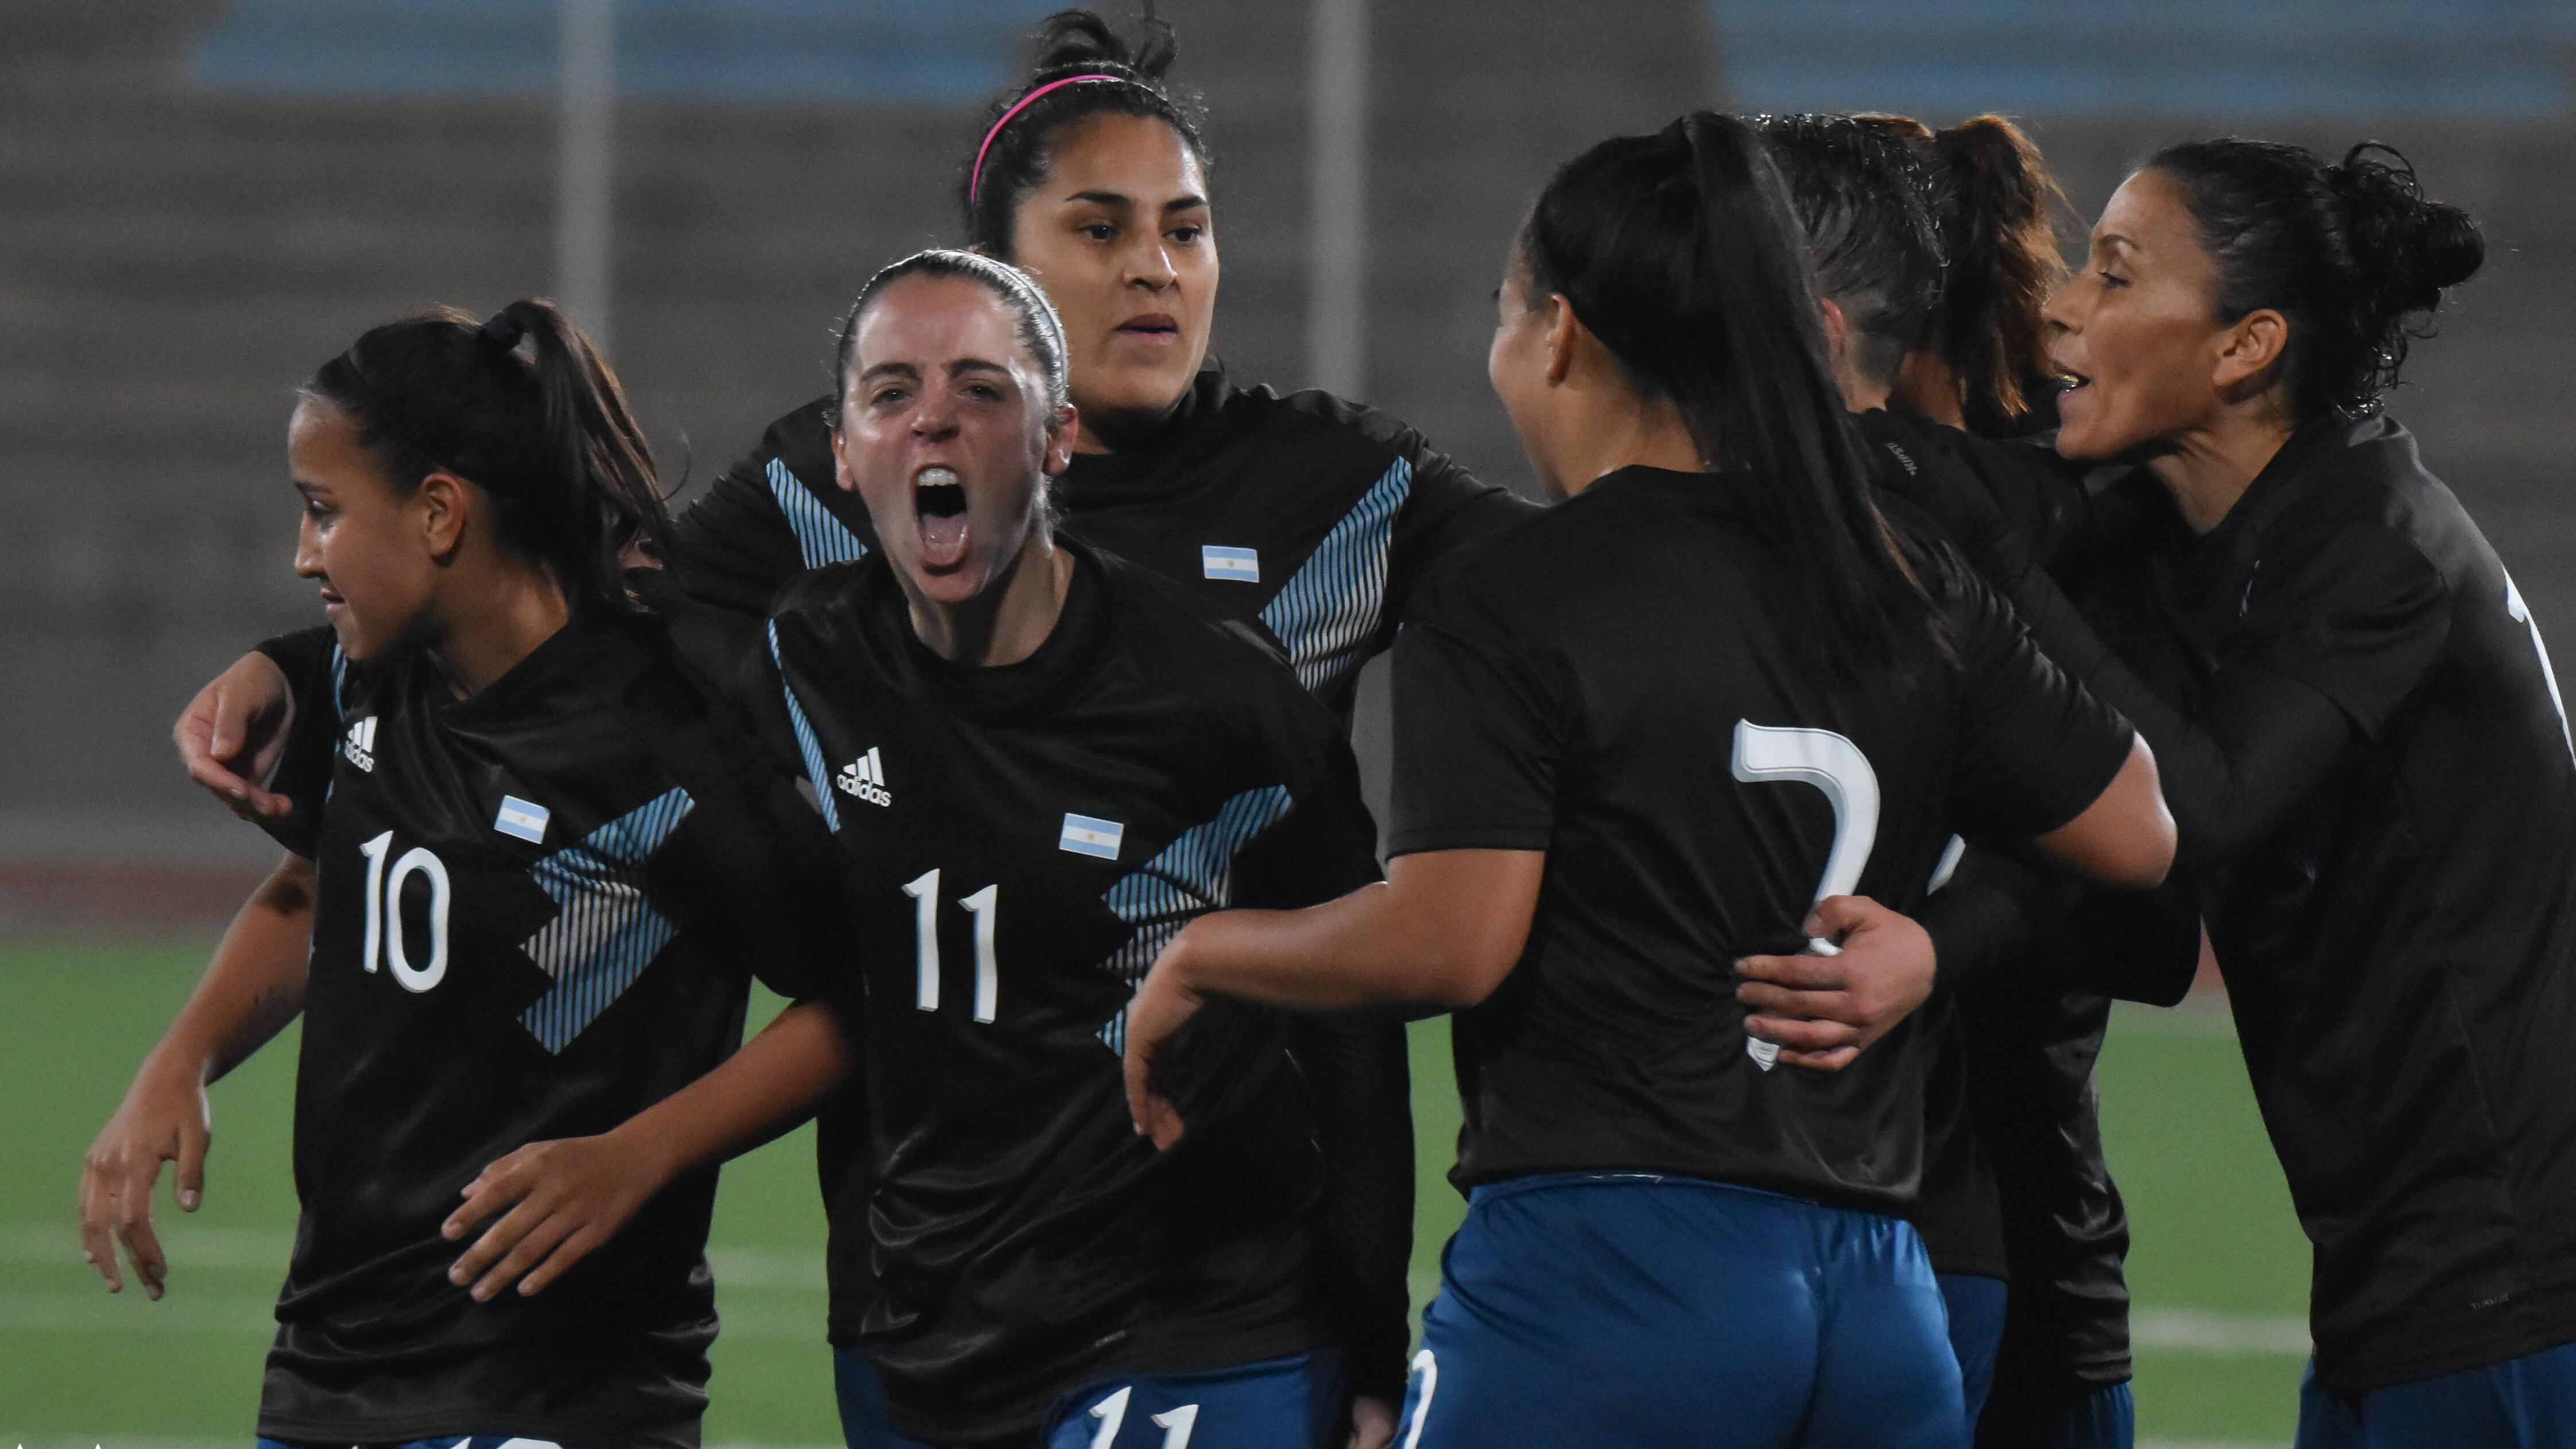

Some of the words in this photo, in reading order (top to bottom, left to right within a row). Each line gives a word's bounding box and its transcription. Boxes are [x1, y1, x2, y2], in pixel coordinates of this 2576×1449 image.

[836, 774, 892, 807] adidas
[1731, 718, 1881, 957] 7
[359, 830, 451, 994] 10
[901, 868, 998, 1025] 11
